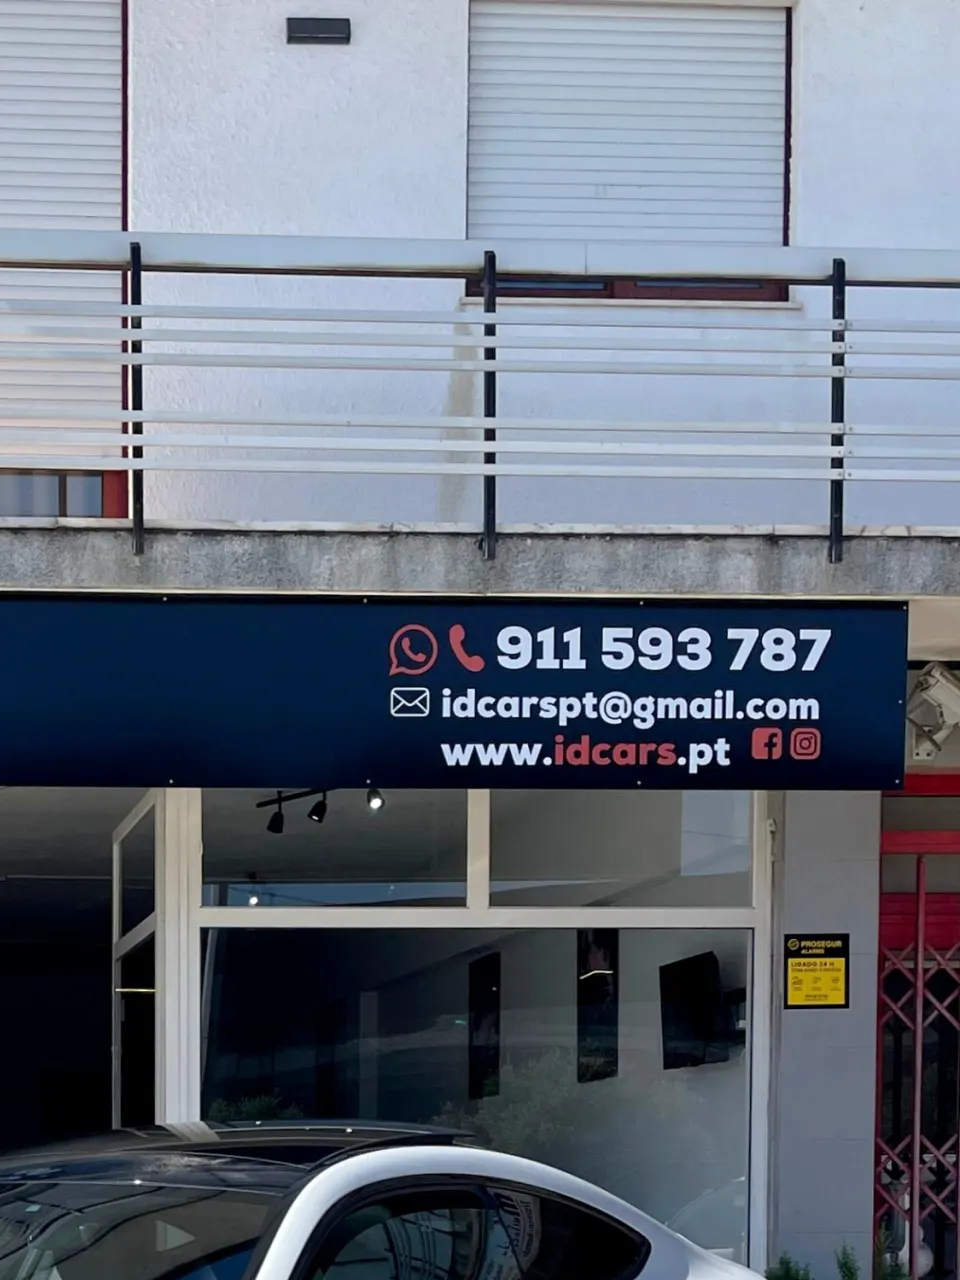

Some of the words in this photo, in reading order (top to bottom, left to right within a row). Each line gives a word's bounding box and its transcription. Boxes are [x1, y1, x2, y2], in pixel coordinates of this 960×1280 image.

[496, 625, 587, 670] 911
[601, 627, 712, 671] 593
[727, 628, 832, 672] 787
[442, 687, 820, 730] idcarspt@gmail.com
[440, 734, 731, 774] www.idcars.pt
[800, 940, 843, 948] PROSEGUR
